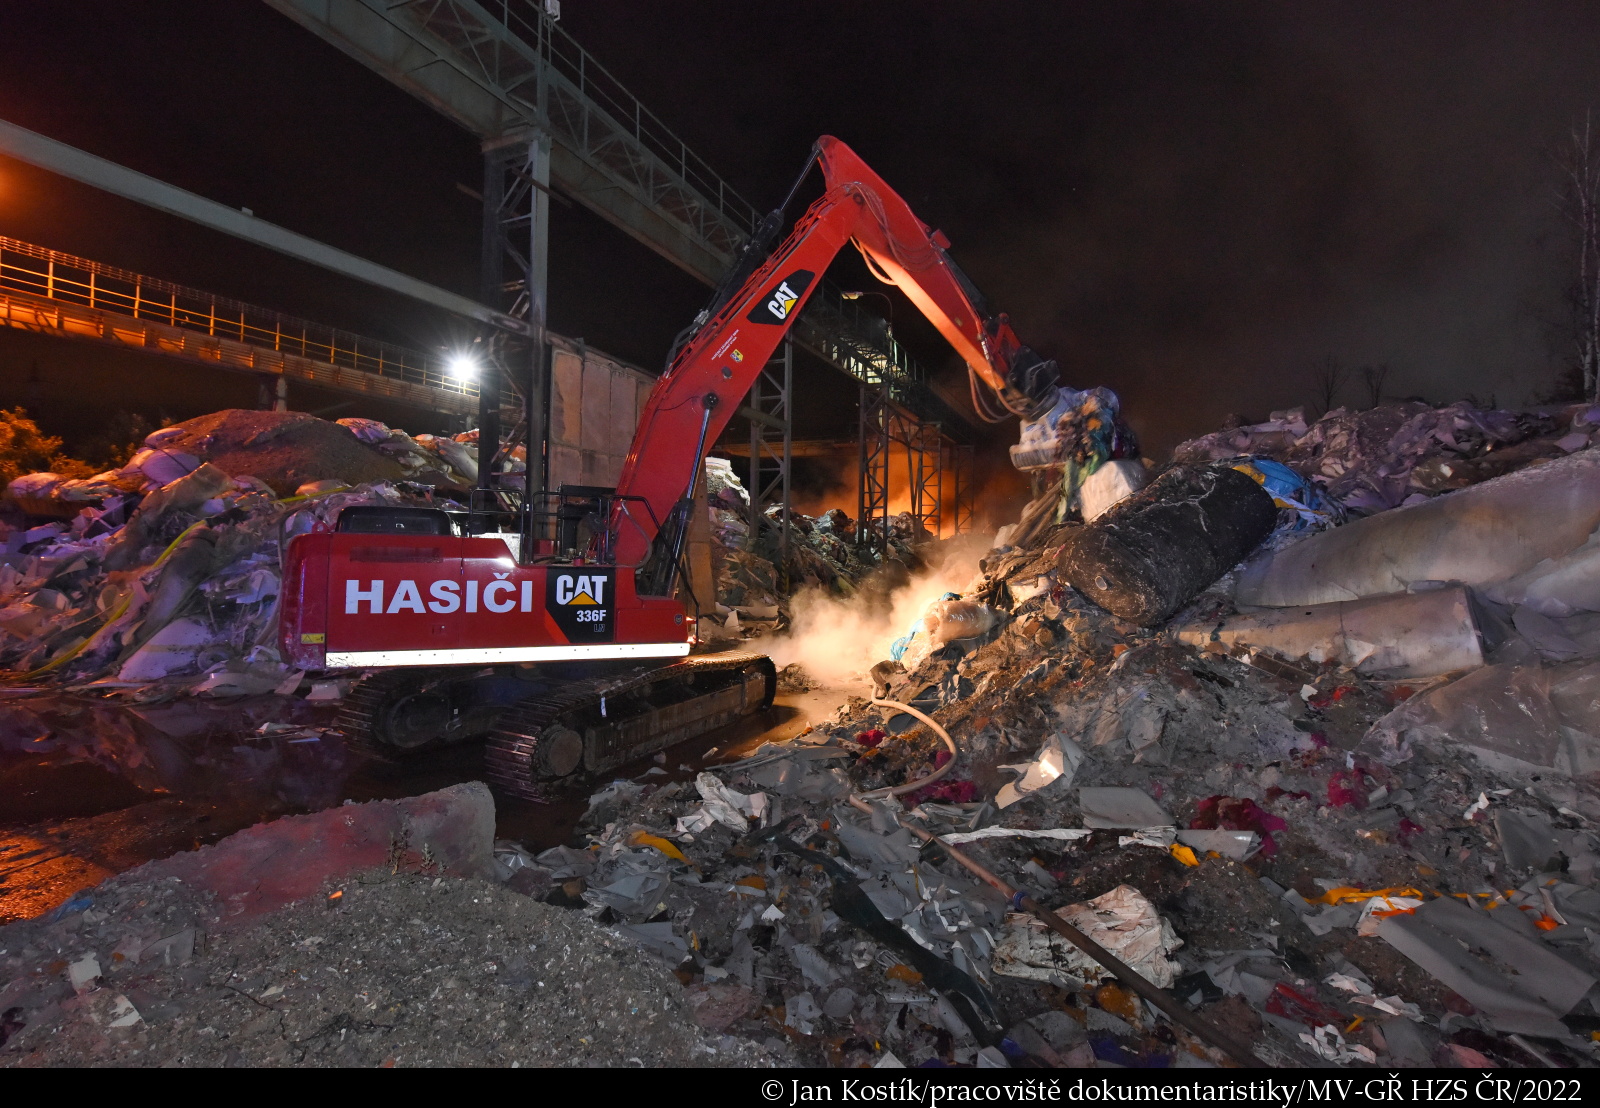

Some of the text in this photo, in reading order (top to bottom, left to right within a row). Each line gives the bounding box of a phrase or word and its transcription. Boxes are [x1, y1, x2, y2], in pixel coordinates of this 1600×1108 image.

[767, 281, 799, 320] CAT
[345, 572, 533, 615] HASIČI
[556, 574, 608, 605] CAT
[576, 609, 607, 622] 336F
